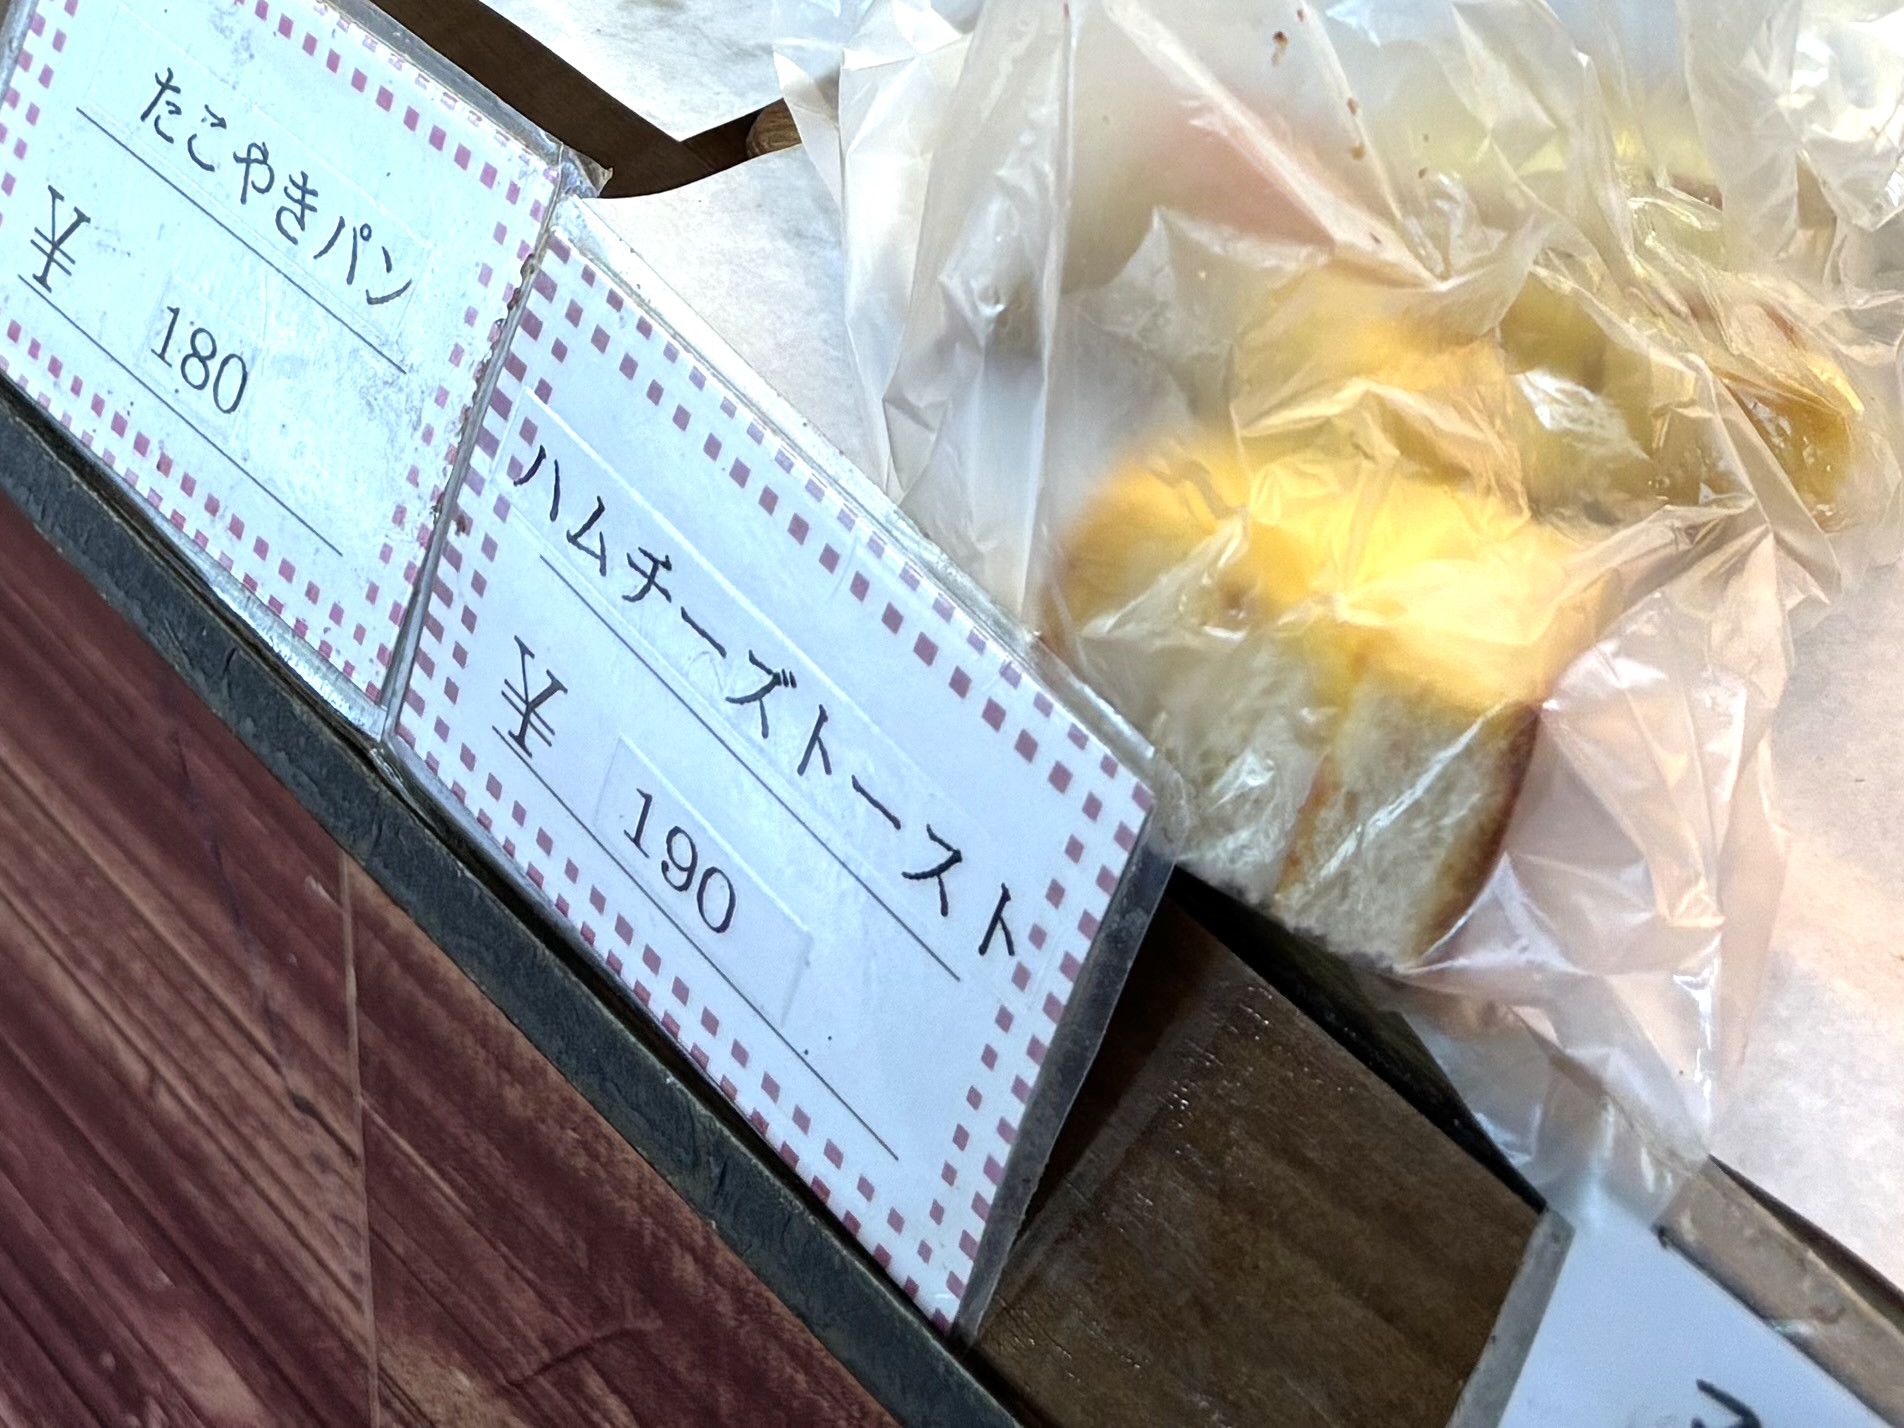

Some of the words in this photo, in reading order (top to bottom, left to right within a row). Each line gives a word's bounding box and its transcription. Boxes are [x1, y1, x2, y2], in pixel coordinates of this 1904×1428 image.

[28, 184, 92, 293] ¥
[149, 304, 250, 417] 180
[138, 65, 415, 306] たこやきパン
[500, 636, 570, 764] ¥
[622, 788, 738, 936] 190
[513, 443, 1019, 960] ハムチーズトースト
